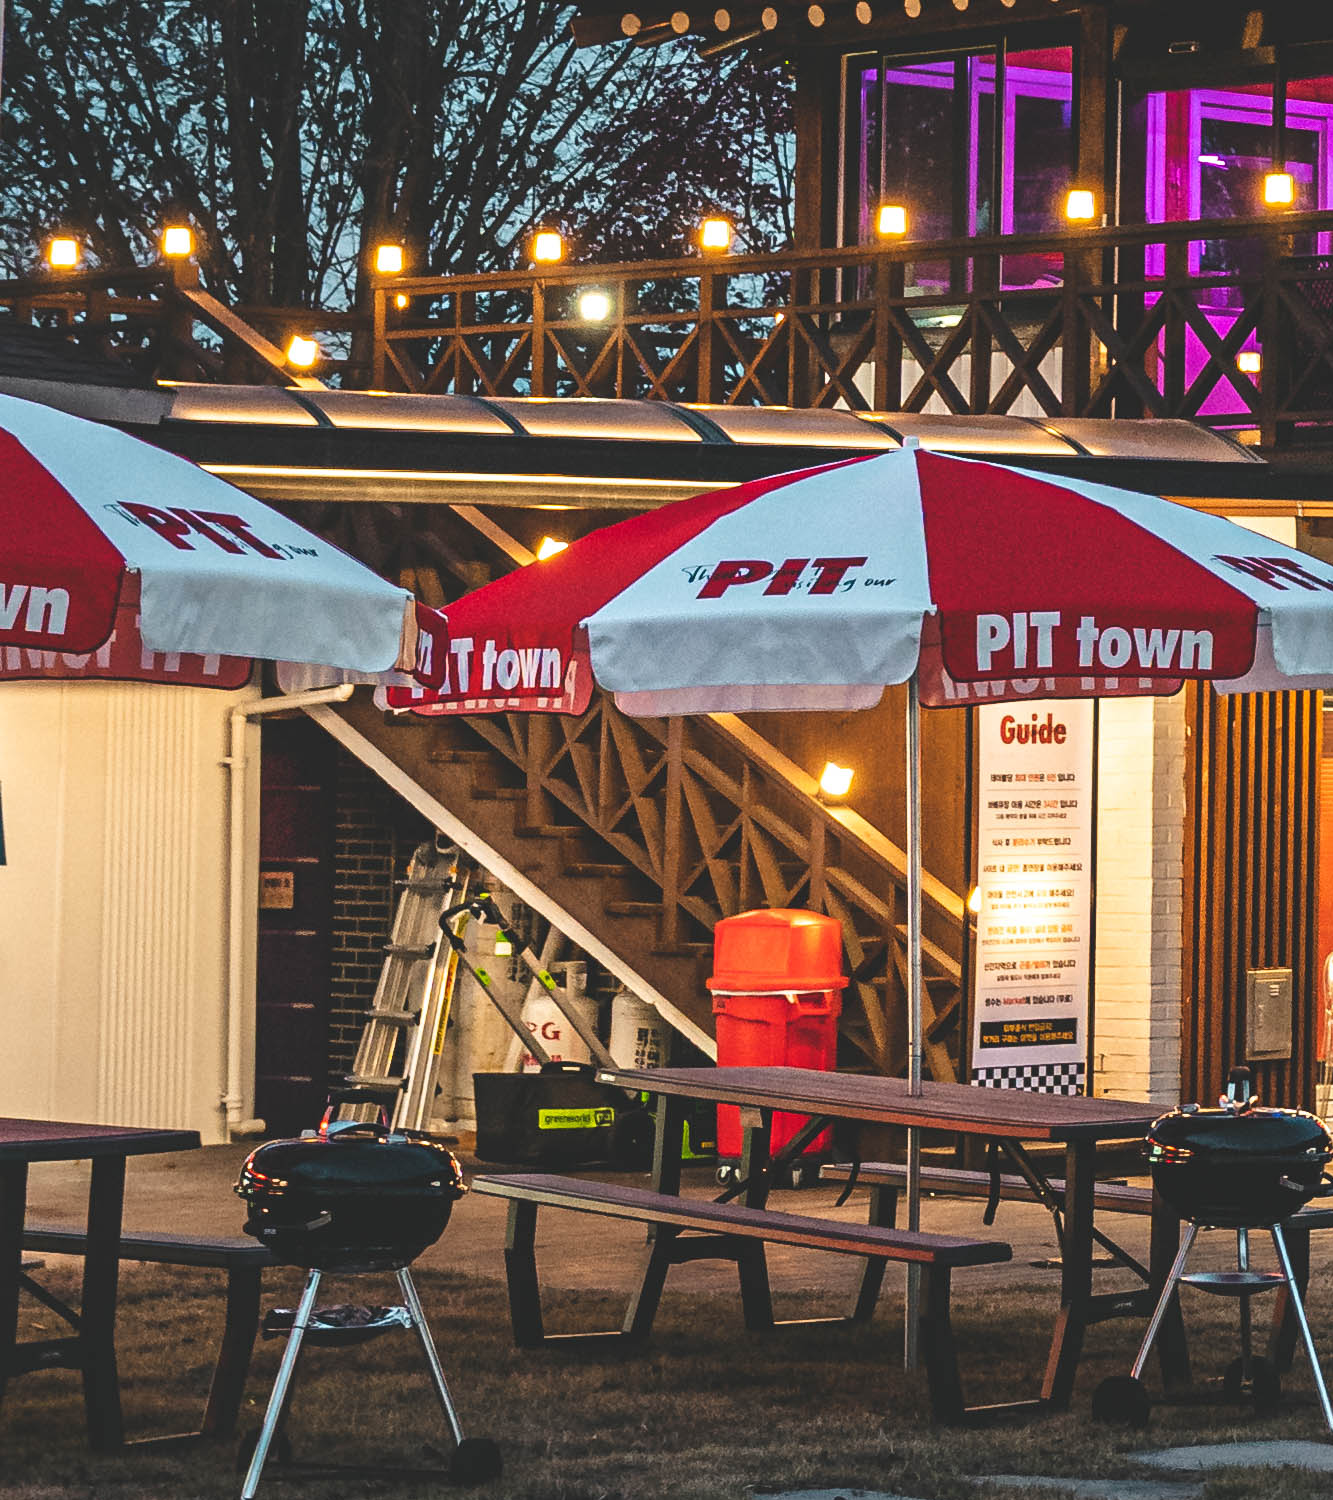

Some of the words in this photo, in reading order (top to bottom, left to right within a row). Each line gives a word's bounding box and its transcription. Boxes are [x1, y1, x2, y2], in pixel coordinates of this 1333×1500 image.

[116, 501, 287, 560] PIT
[696, 557, 868, 599] PIT
[482, 639, 561, 691] town
[976, 611, 1061, 671] PIT
[1076, 616, 1213, 670] town
[1000, 713, 1067, 744] Guide
